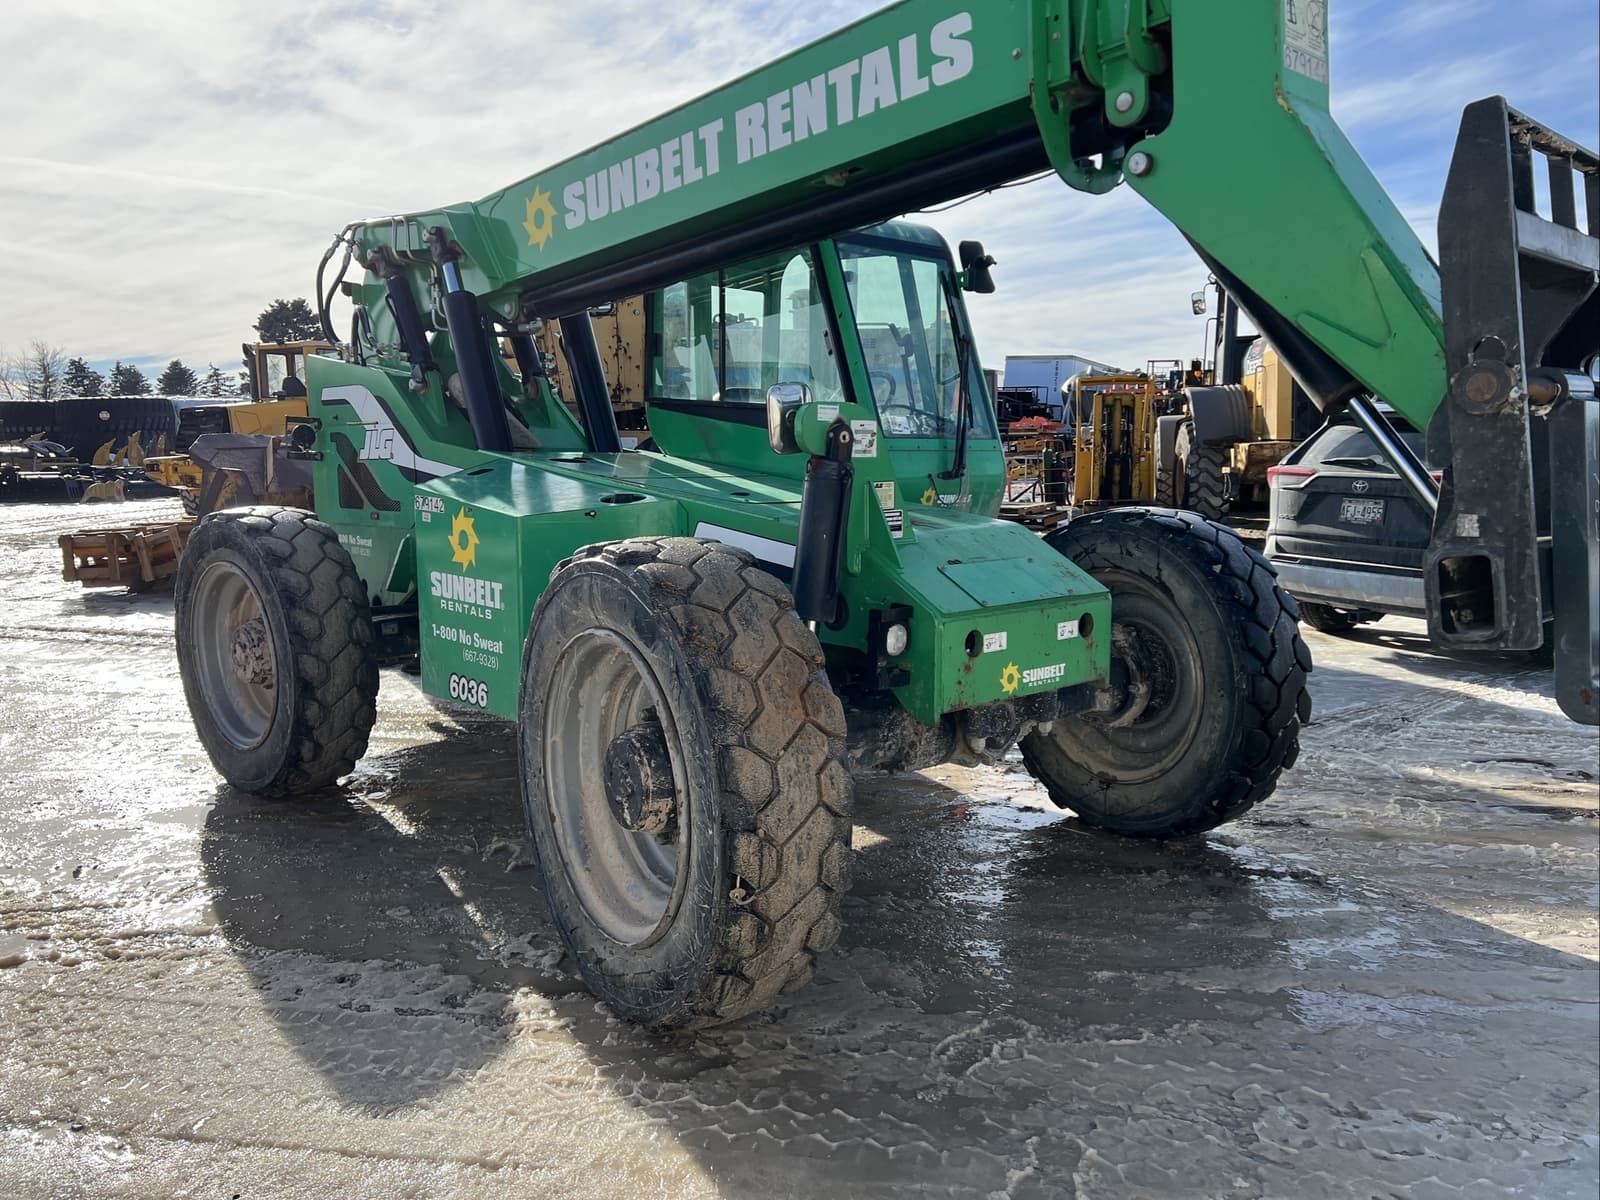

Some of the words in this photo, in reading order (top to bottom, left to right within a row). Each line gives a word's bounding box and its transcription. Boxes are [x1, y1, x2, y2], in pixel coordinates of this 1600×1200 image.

[563, 118, 723, 230] SUNBELT
[735, 12, 974, 164] RENTALS
[359, 428, 394, 460] JLG
[416, 495, 444, 513] 679142
[430, 571, 503, 609] SUNBELT
[440, 600, 492, 619] RENTALS
[432, 624, 457, 641] 1-800
[459, 629, 472, 644] No
[473, 632, 503, 654] Sweat
[462, 649, 499, 671] (667-9328)
[1022, 663, 1066, 683] SUNBELT
[449, 673, 488, 708] 6036
[1028, 677, 1060, 687] RENTALS
